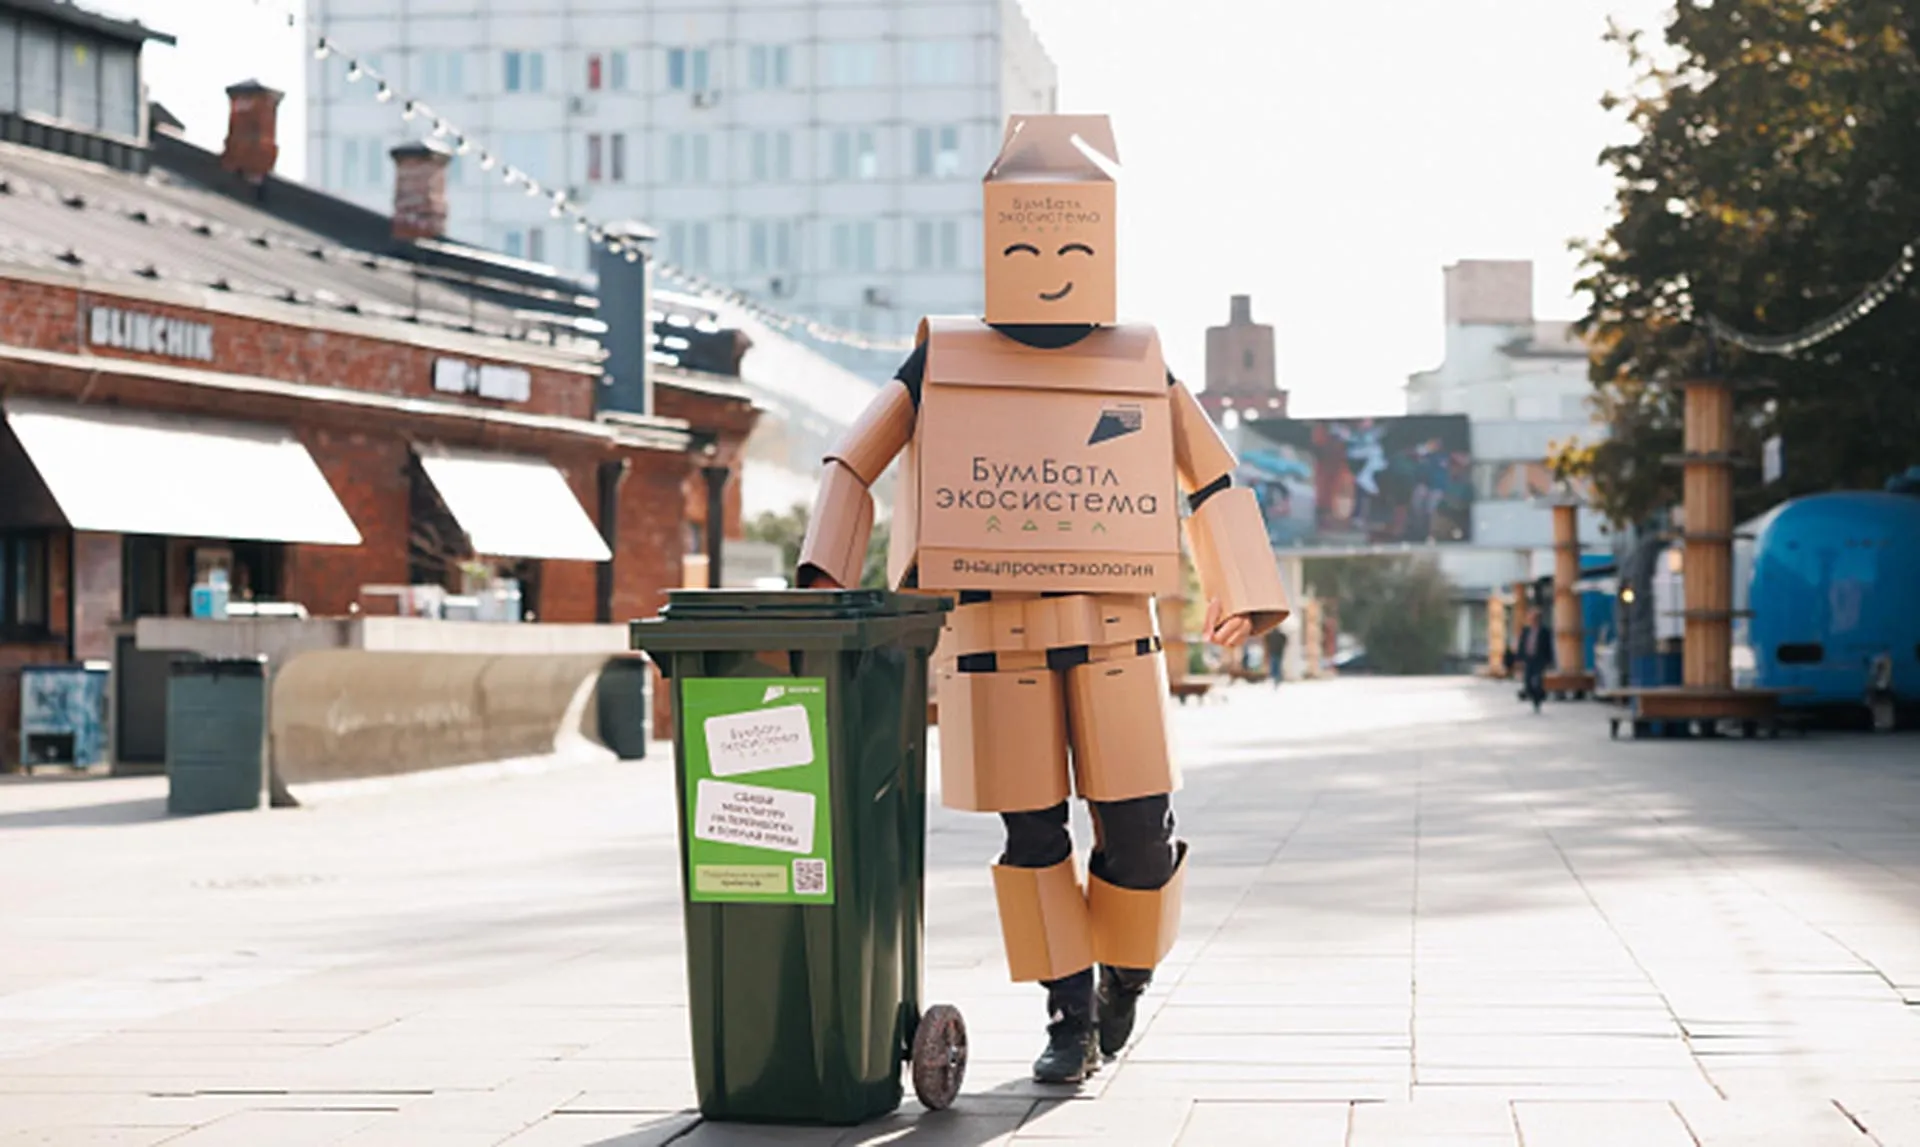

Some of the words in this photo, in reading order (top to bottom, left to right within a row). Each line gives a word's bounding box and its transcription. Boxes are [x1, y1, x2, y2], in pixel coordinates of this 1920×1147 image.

[972, 456, 1120, 488] БумБатл
[935, 487, 1158, 515] экосистема
[952, 558, 1155, 578] #нацпроектэкология
